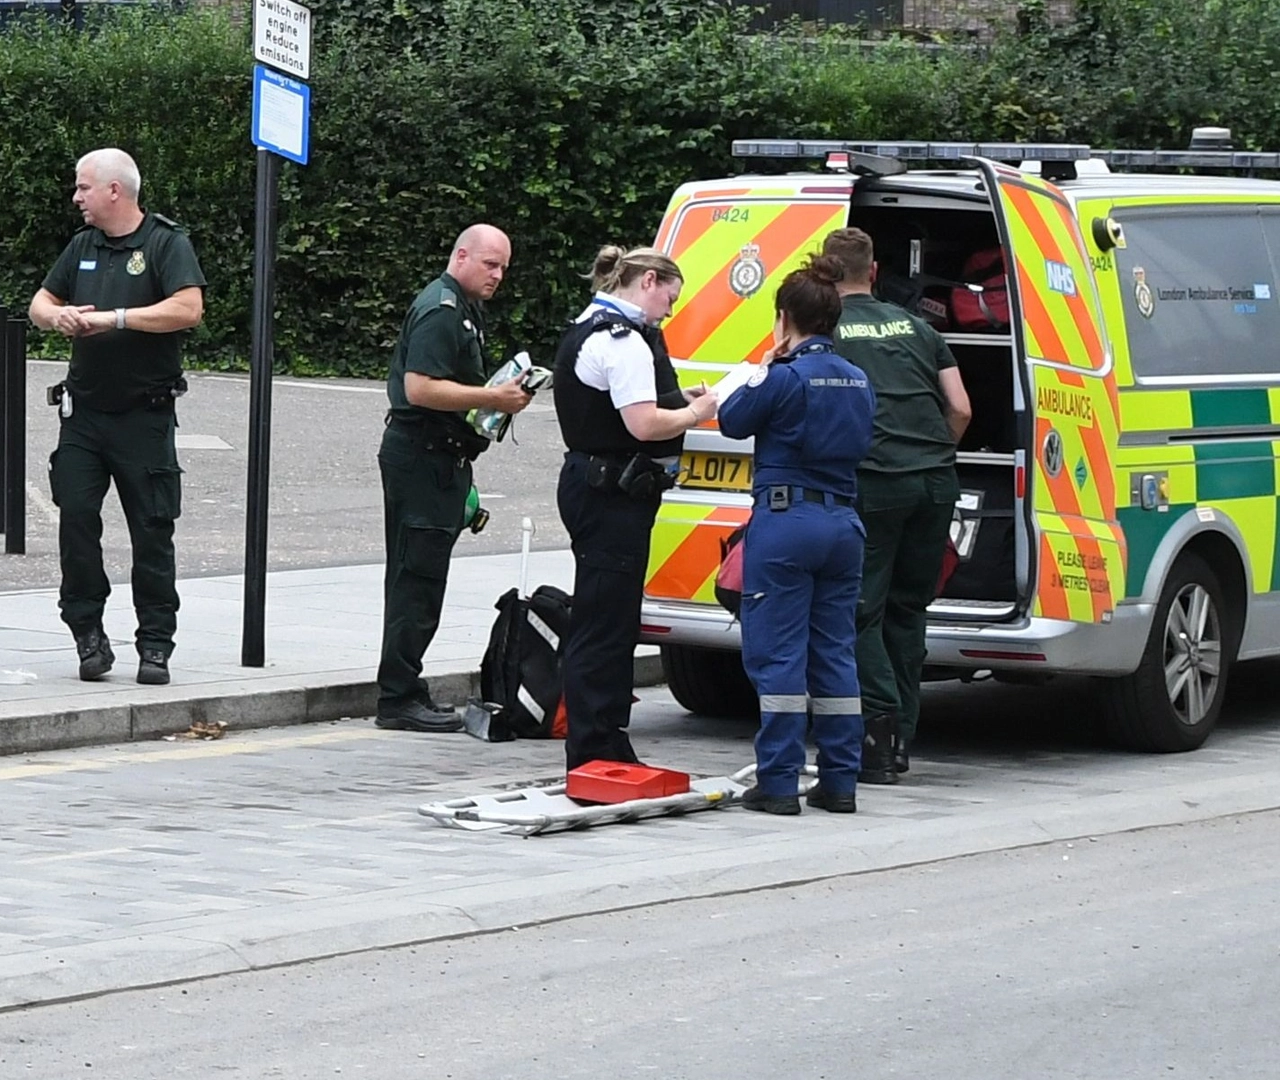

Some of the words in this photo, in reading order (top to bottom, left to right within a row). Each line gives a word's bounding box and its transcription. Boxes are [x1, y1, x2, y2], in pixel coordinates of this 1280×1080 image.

[267, 17, 298, 37] engine
[293, 11, 307, 25] off
[265, 29, 300, 54] Reduce
[260, 46, 304, 71] emissions
[1046, 260, 1077, 297] NHS
[1157, 287, 1186, 301] London
[1187, 287, 1229, 301] Ambulance
[839, 320, 915, 340] AMBULANCE
[1037, 386, 1092, 421] AMBULANCE
[1057, 550, 1086, 569] PLEASE
[1058, 573, 1088, 592] METRES
